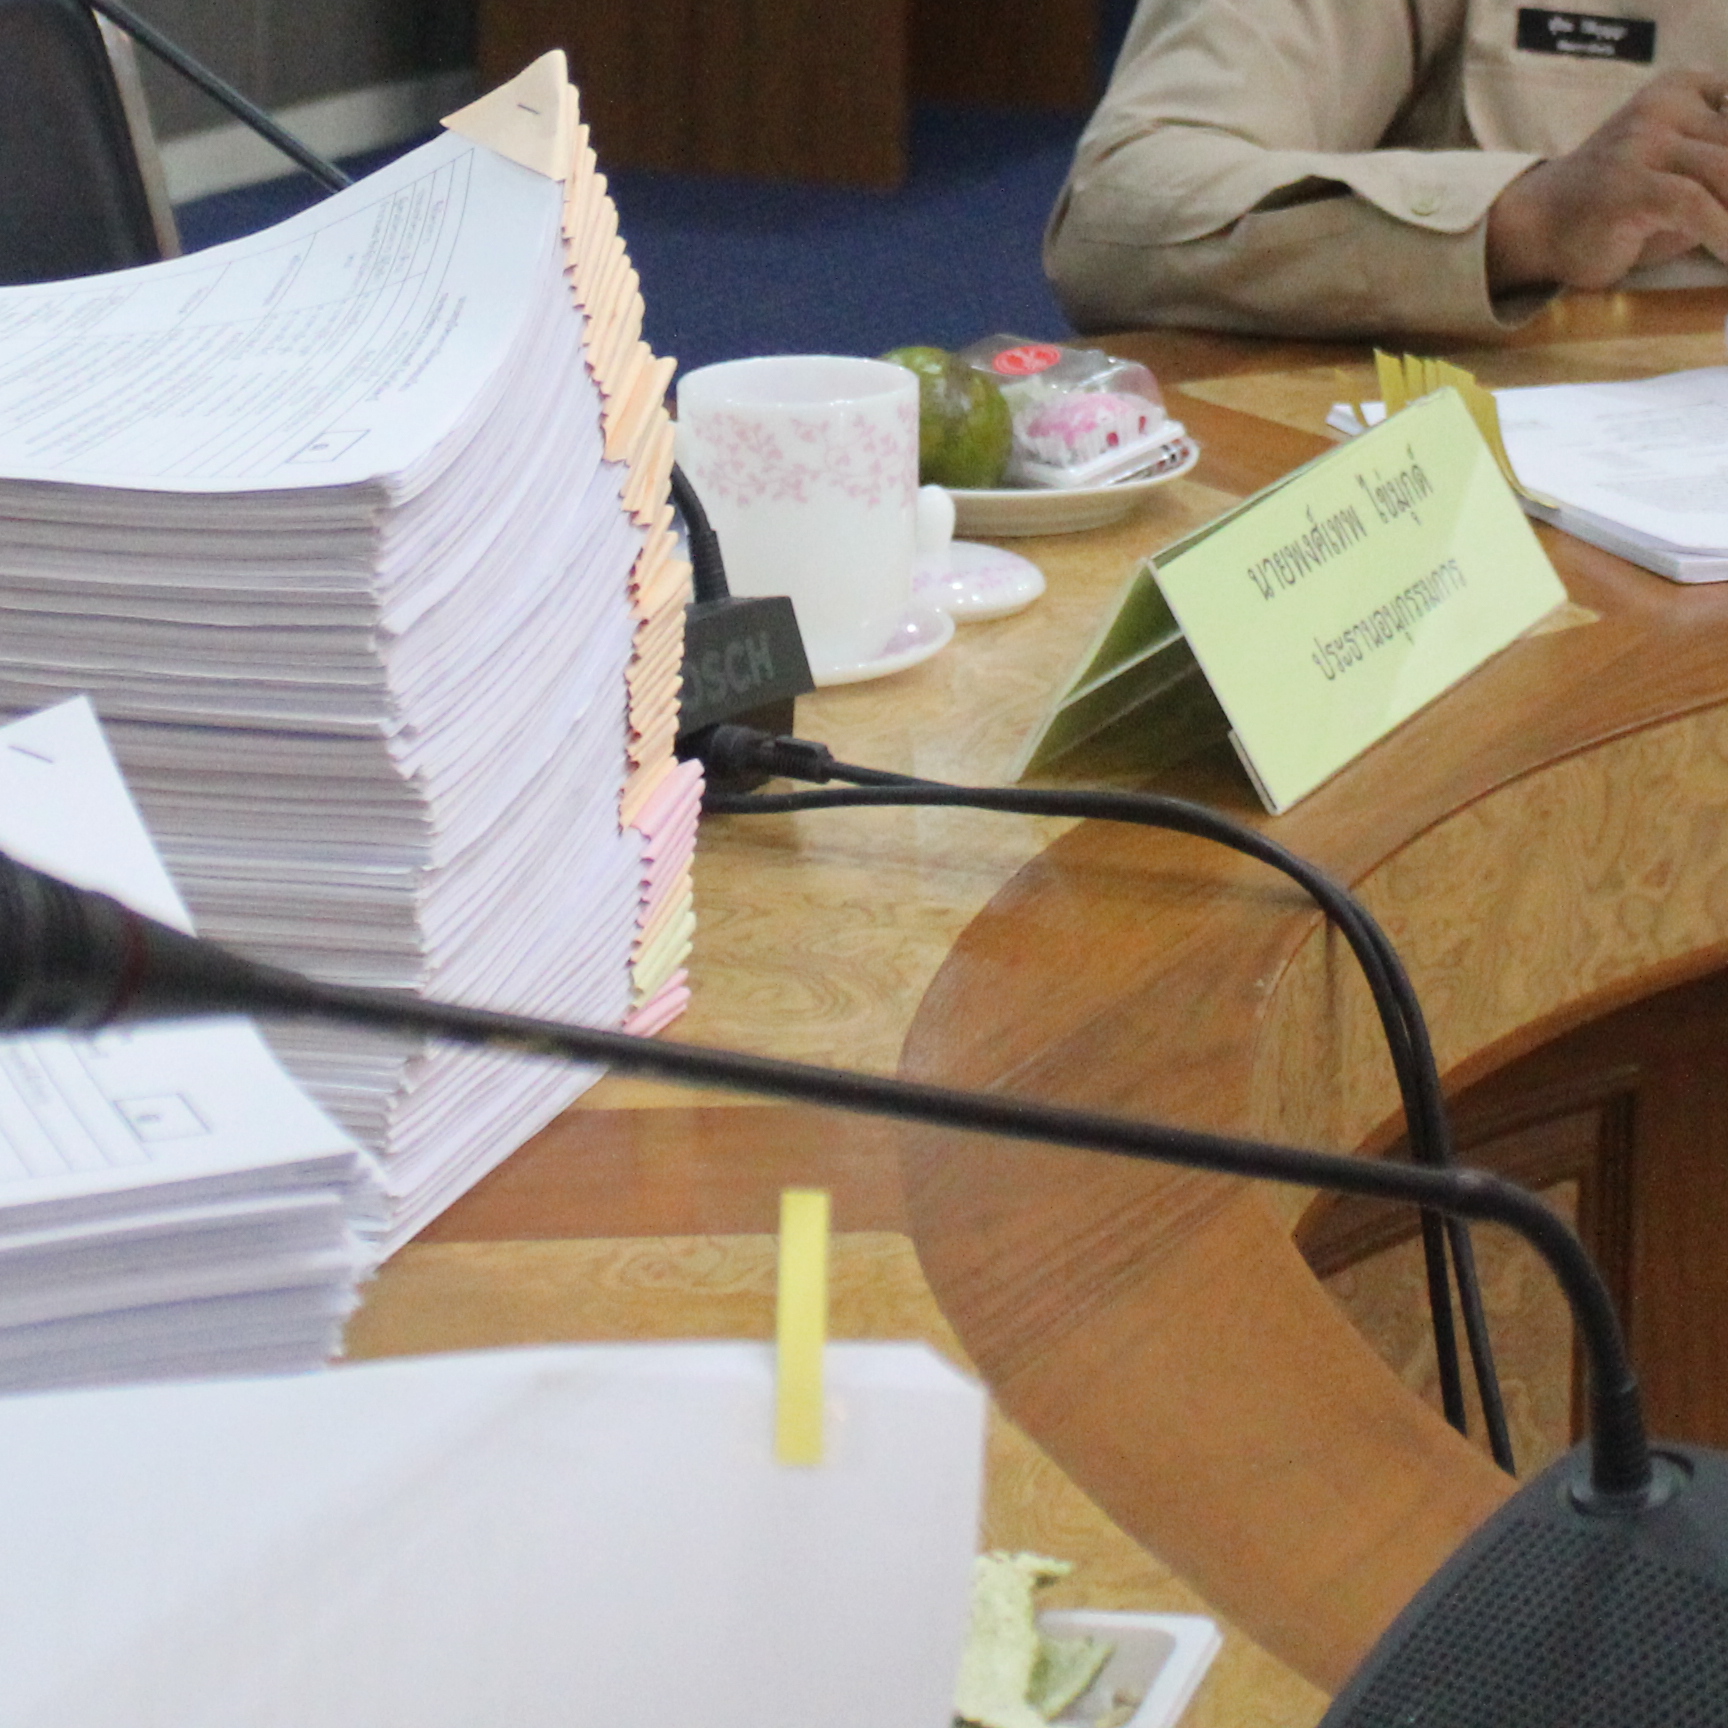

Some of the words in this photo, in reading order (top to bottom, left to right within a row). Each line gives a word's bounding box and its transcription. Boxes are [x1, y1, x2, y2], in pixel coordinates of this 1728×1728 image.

[1247, 506, 1368, 602] นายพงศ์เทพ
[682, 630, 774, 710] OSCH
